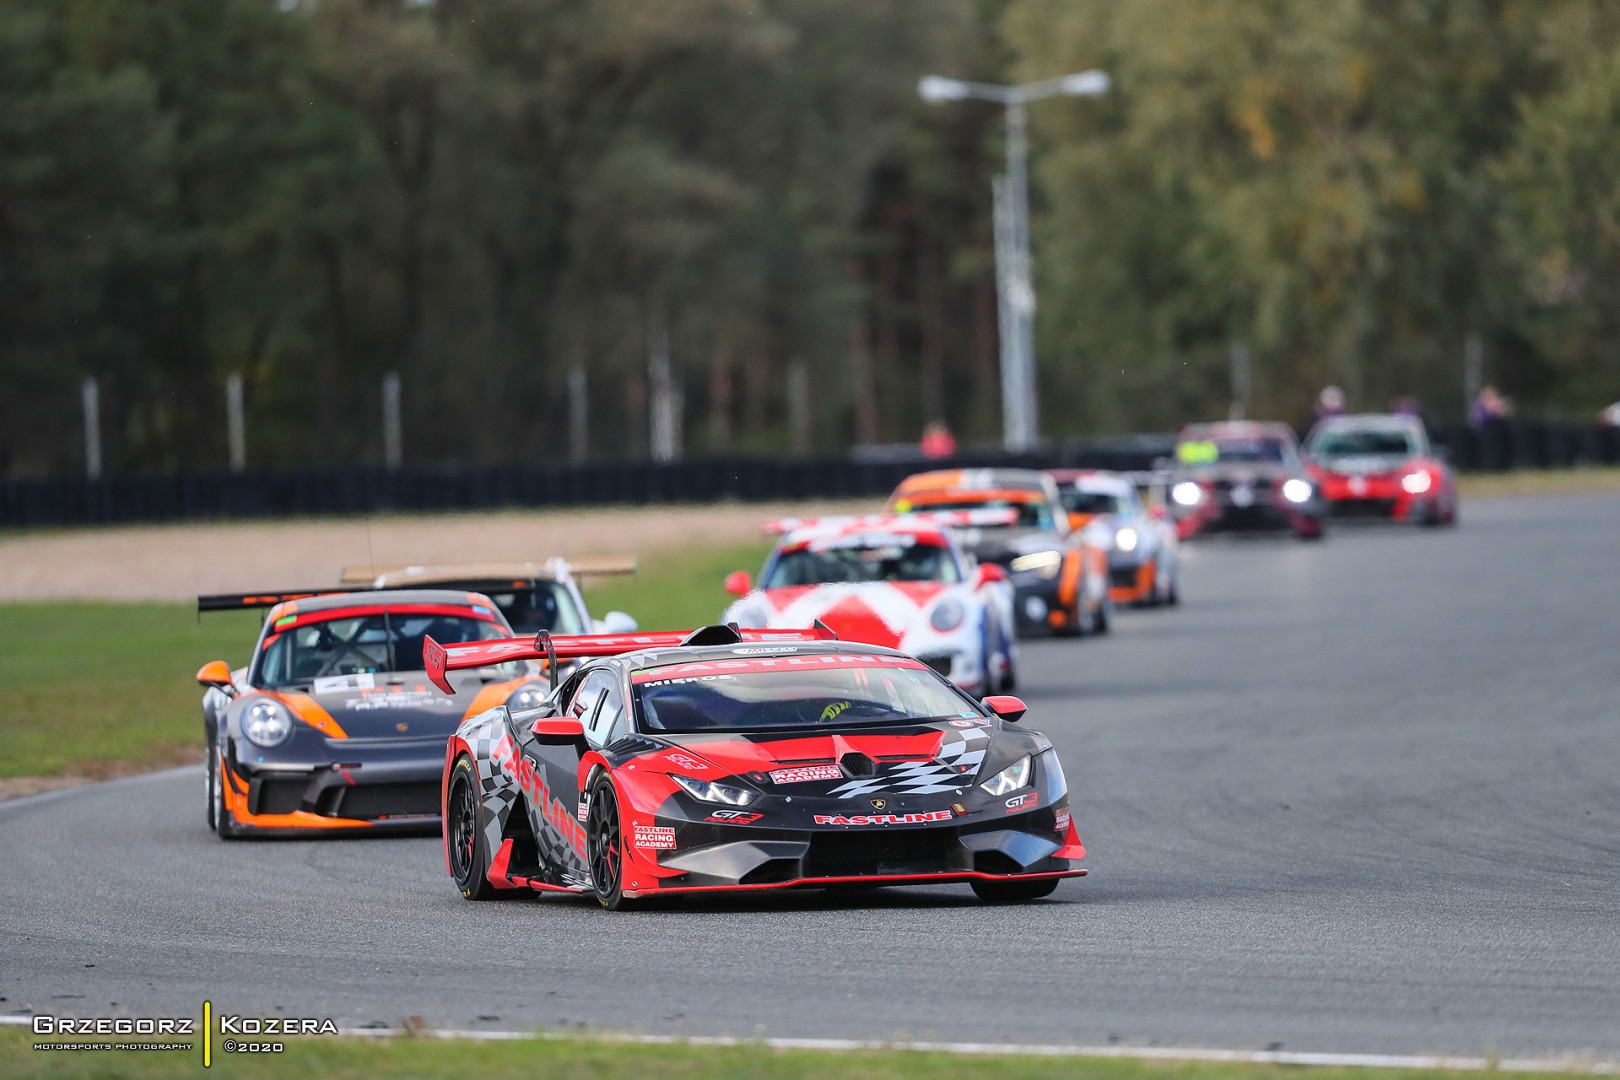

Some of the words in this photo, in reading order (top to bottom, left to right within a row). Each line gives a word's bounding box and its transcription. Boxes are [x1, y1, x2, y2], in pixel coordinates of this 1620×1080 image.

[446, 632, 815, 657] FASTLE
[648, 655, 911, 676] FASTLINE
[775, 769, 839, 779] RACING
[777, 773, 840, 783] ACADEMY
[492, 733, 587, 861] FASTLINE
[1005, 791, 1038, 808] GT3
[711, 809, 764, 822] GT3
[813, 810, 953, 826] FASTLINE
[635, 833, 674, 842] RACING
